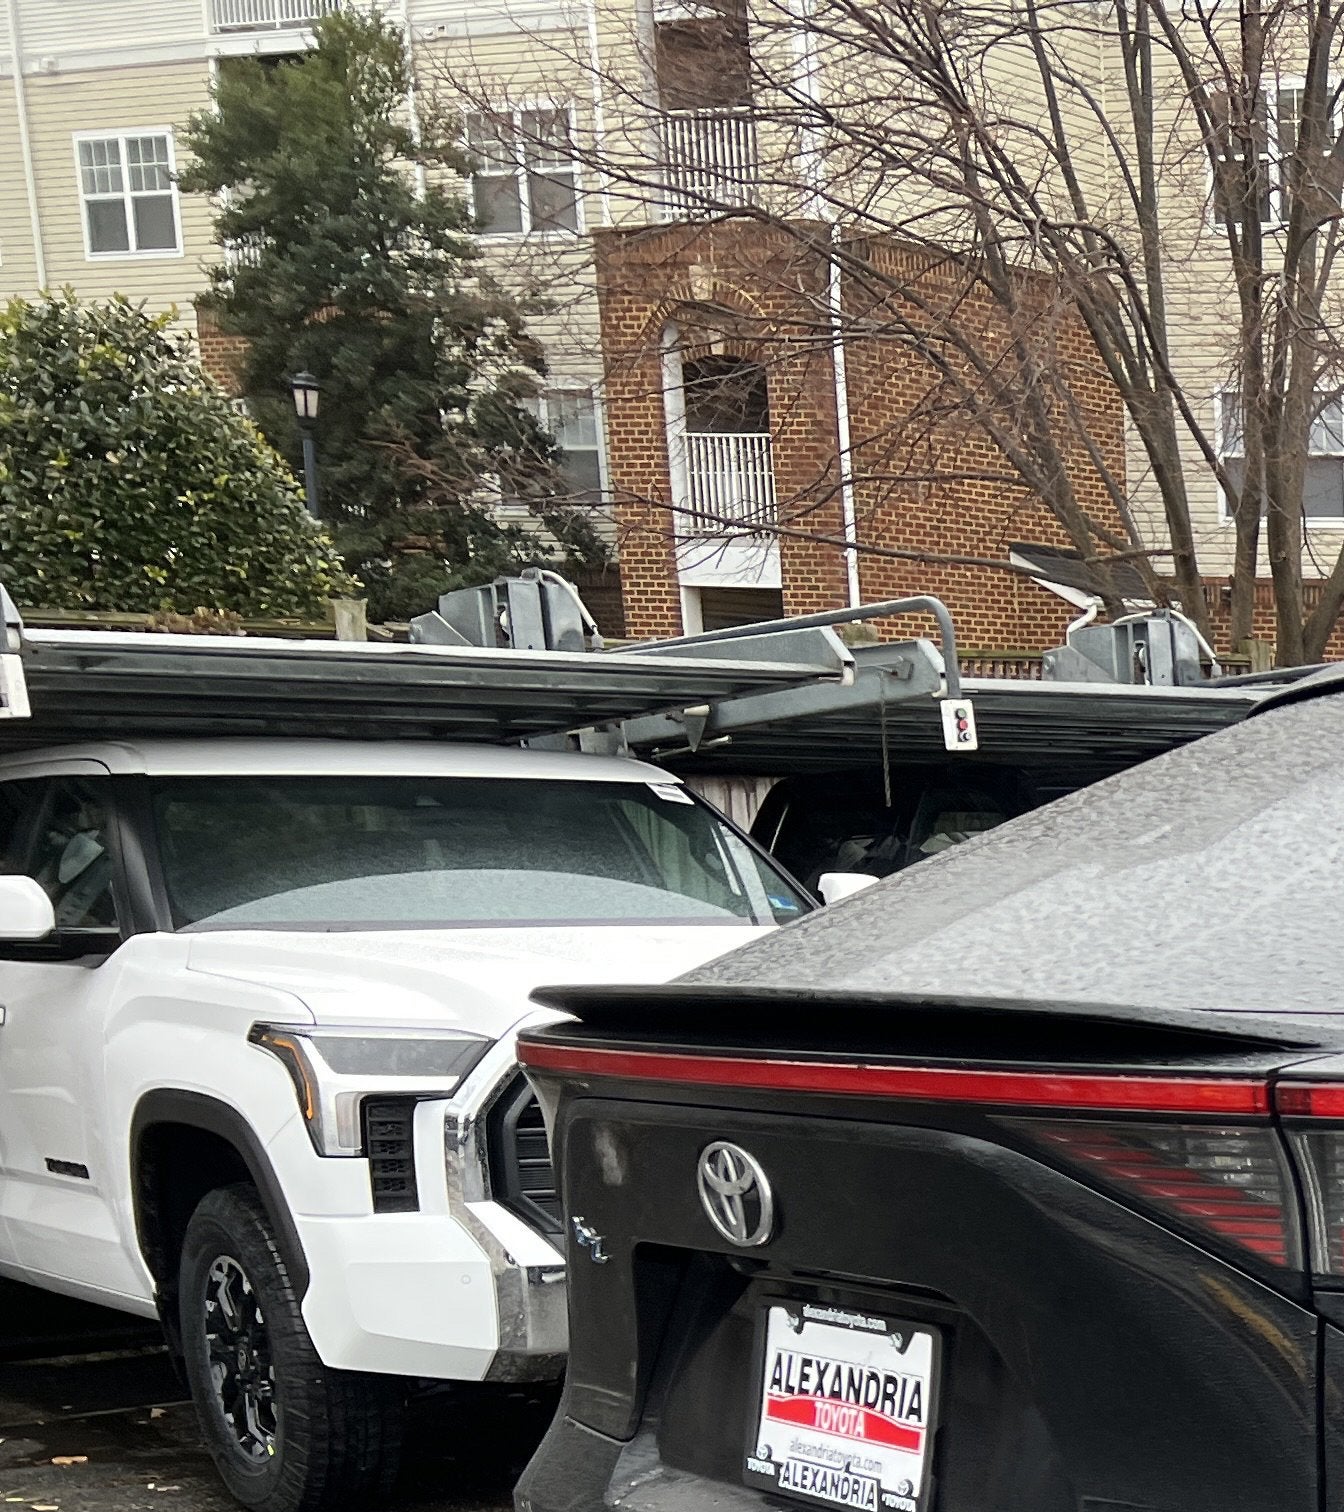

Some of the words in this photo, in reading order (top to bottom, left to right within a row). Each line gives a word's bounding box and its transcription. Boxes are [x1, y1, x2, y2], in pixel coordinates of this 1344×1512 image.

[769, 1352, 923, 1422] ALEXANDRIA
[814, 1402, 866, 1438] TOYOTA
[789, 1436, 883, 1473] alexandriatoyota.com
[780, 1461, 876, 1510] ALEXANDRIA
